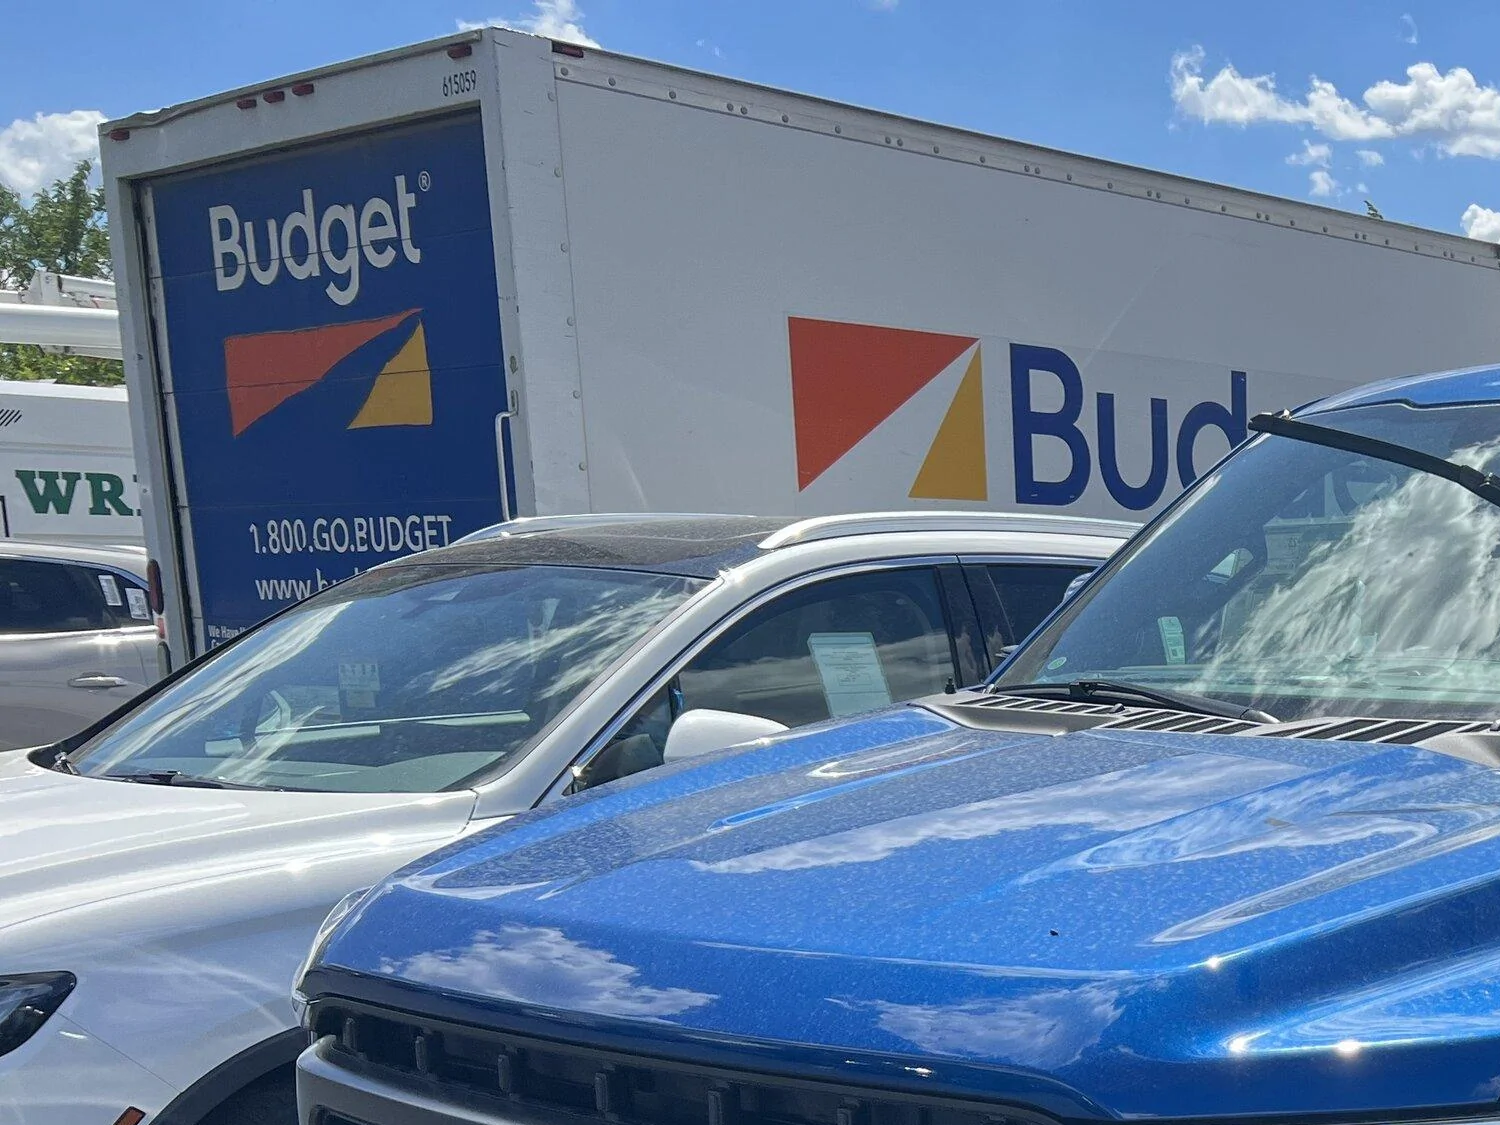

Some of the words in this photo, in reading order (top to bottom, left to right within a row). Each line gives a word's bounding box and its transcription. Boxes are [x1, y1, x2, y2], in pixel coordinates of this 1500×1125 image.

[442, 70, 477, 97] 615059
[14, 469, 142, 517] WR
[249, 515, 452, 554] 1.800.GO.BUDGET
